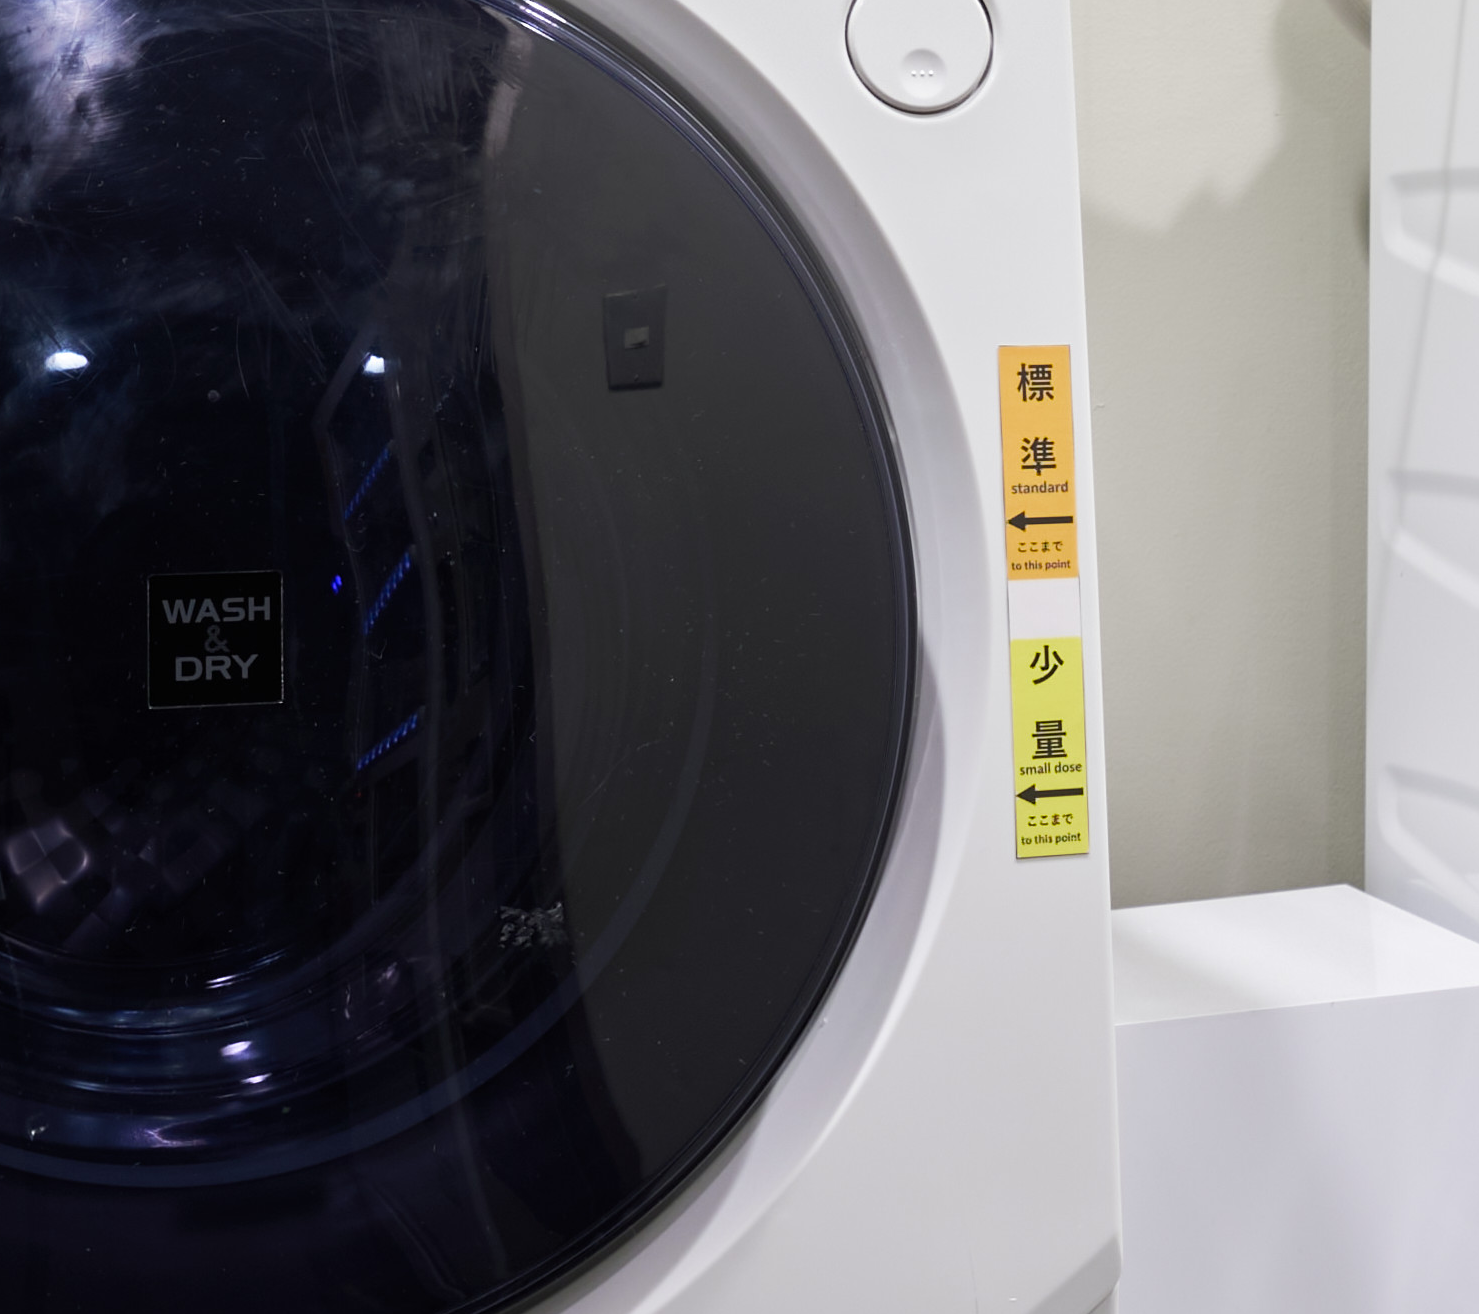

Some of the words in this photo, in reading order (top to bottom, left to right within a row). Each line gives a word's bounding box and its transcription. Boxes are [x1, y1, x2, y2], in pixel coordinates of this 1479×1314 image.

[1017, 363, 1056, 475] 標準
[1011, 482, 1068, 494] standard
[1017, 541, 1063, 552] ここまで
[1011, 559, 1022, 570] to
[1025, 559, 1042, 570] this
[1045, 559, 1070, 572] point
[162, 596, 271, 624] WASH
[204, 625, 230, 653] &
[175, 654, 259, 682] DRY
[1030, 645, 1067, 759] 少量
[1020, 762, 1051, 775] small
[1055, 762, 1082, 774] dose
